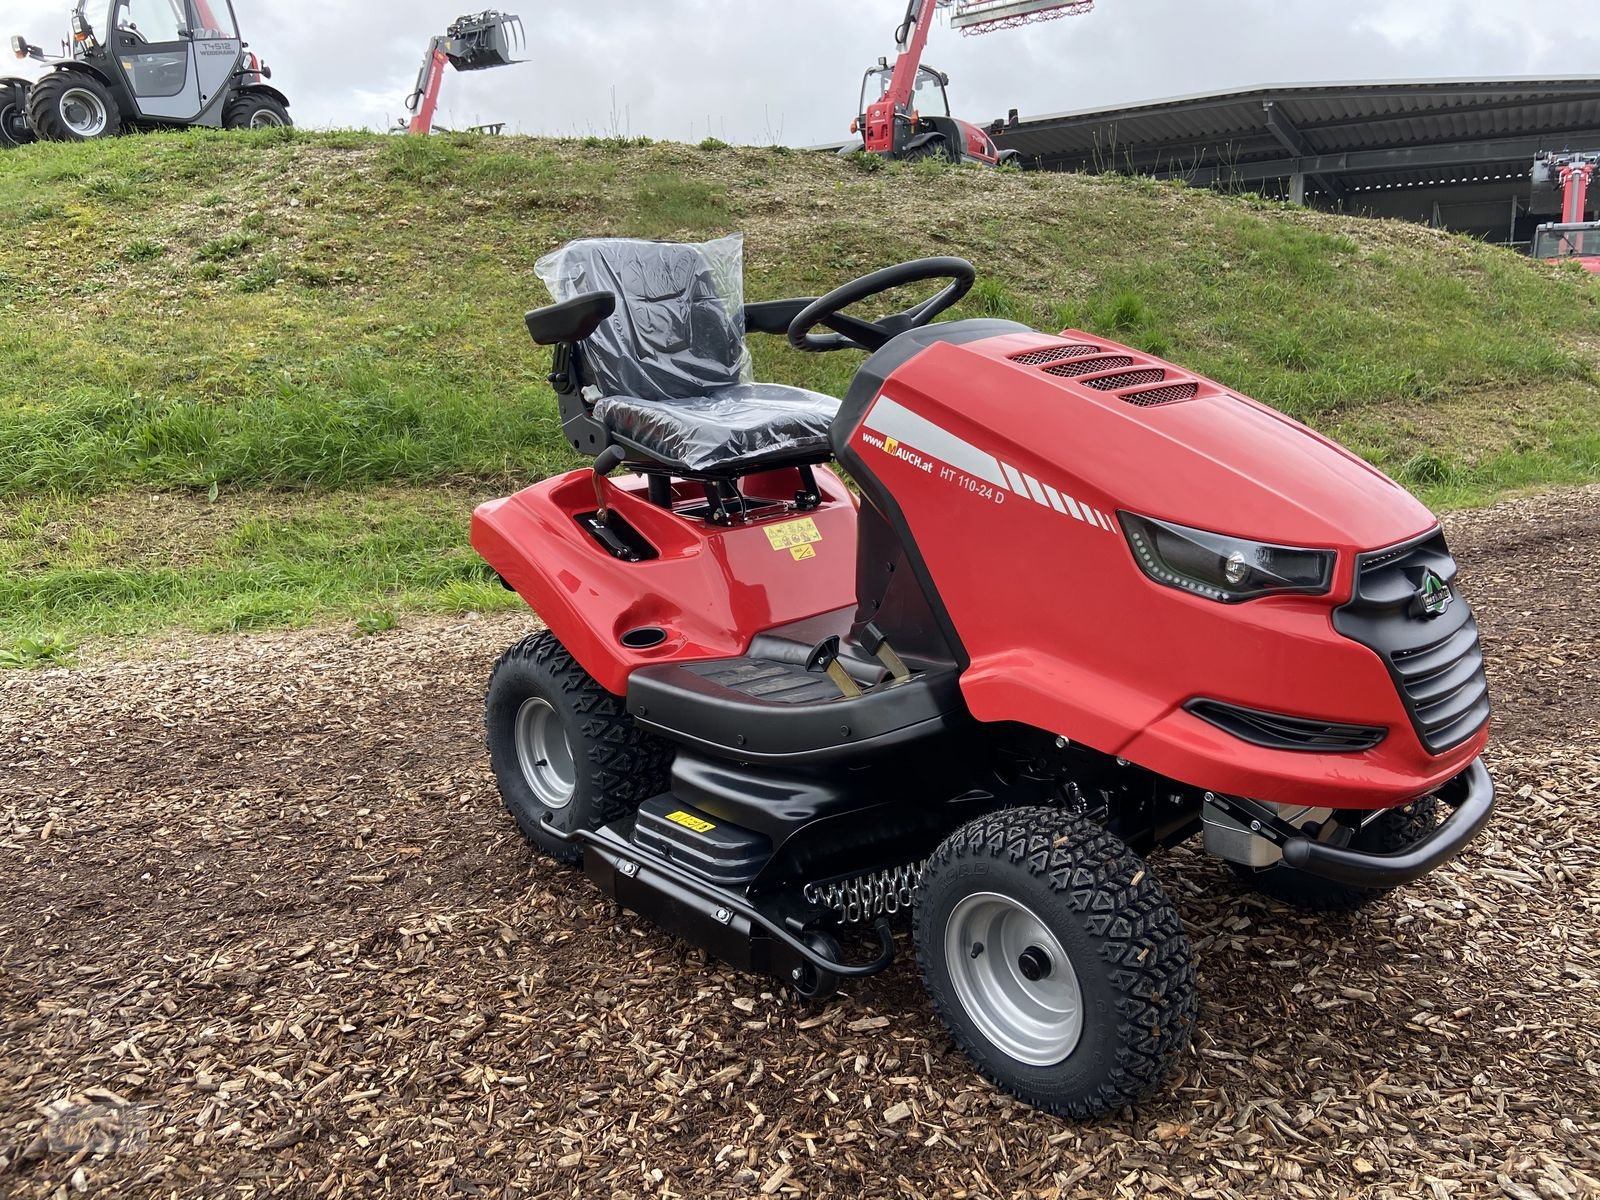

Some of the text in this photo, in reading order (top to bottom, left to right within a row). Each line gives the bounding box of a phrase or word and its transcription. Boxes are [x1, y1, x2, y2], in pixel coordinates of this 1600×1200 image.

[201, 42, 232, 50] T4512
[862, 432, 934, 474] www.MAUCH.at
[939, 466, 1005, 504] HT 110-24 D
